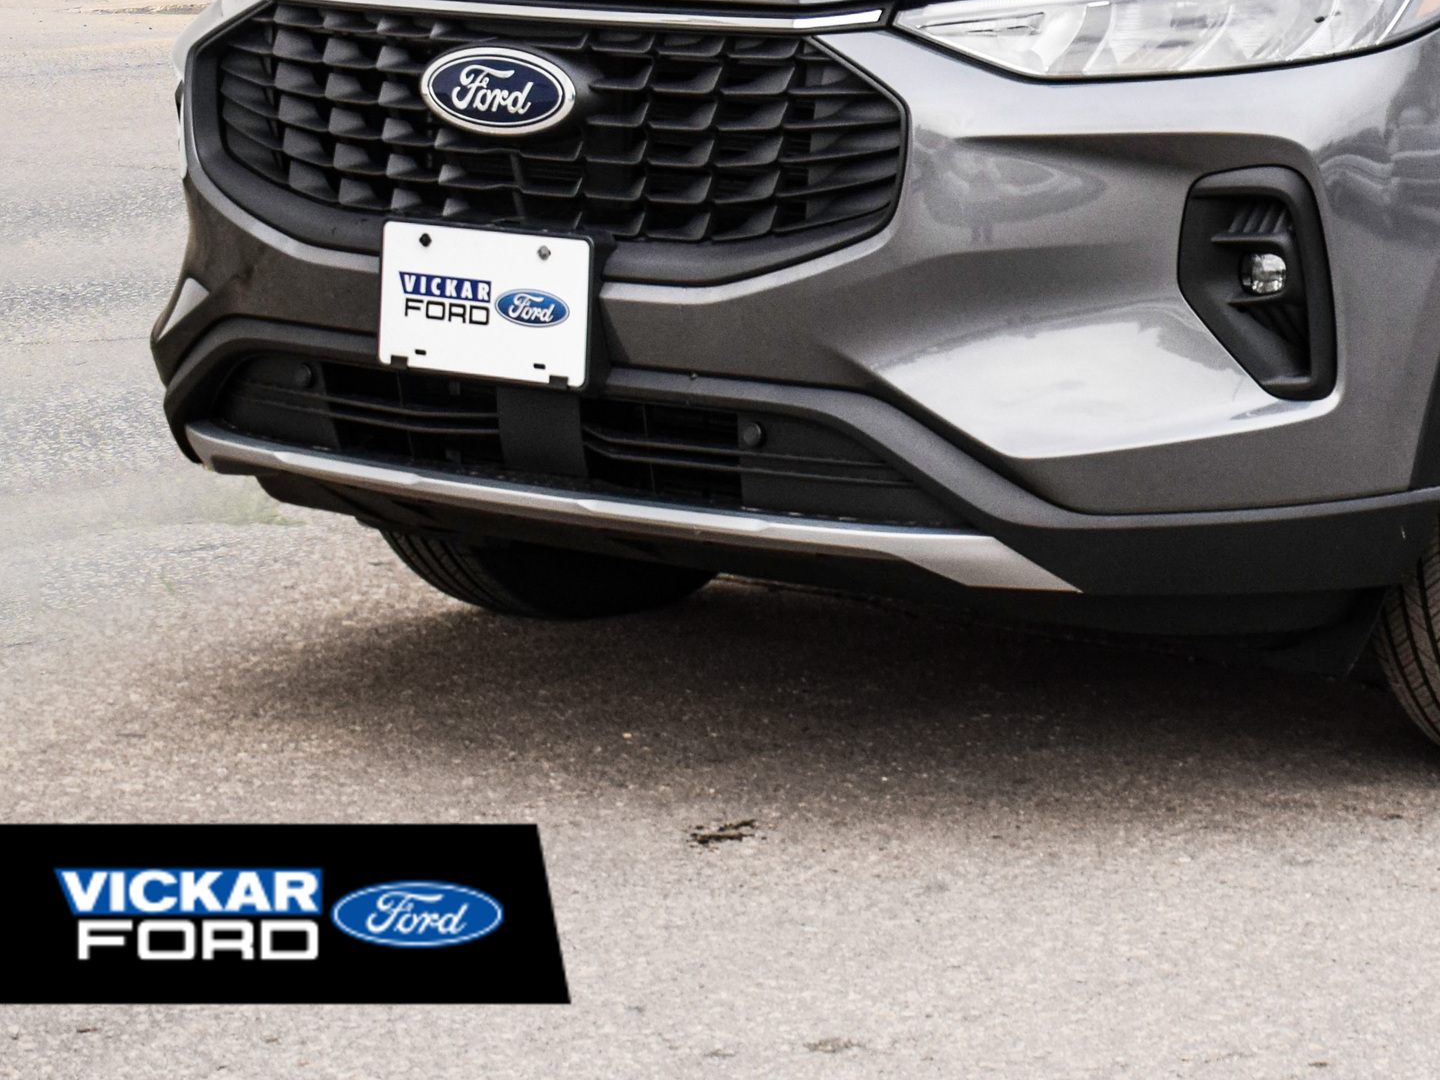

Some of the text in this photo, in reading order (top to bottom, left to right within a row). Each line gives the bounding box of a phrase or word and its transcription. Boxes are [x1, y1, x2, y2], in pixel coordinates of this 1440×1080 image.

[451, 64, 534, 115] Ford
[402, 273, 555, 324] VICKAR Ford
[404, 298, 491, 326] FORD
